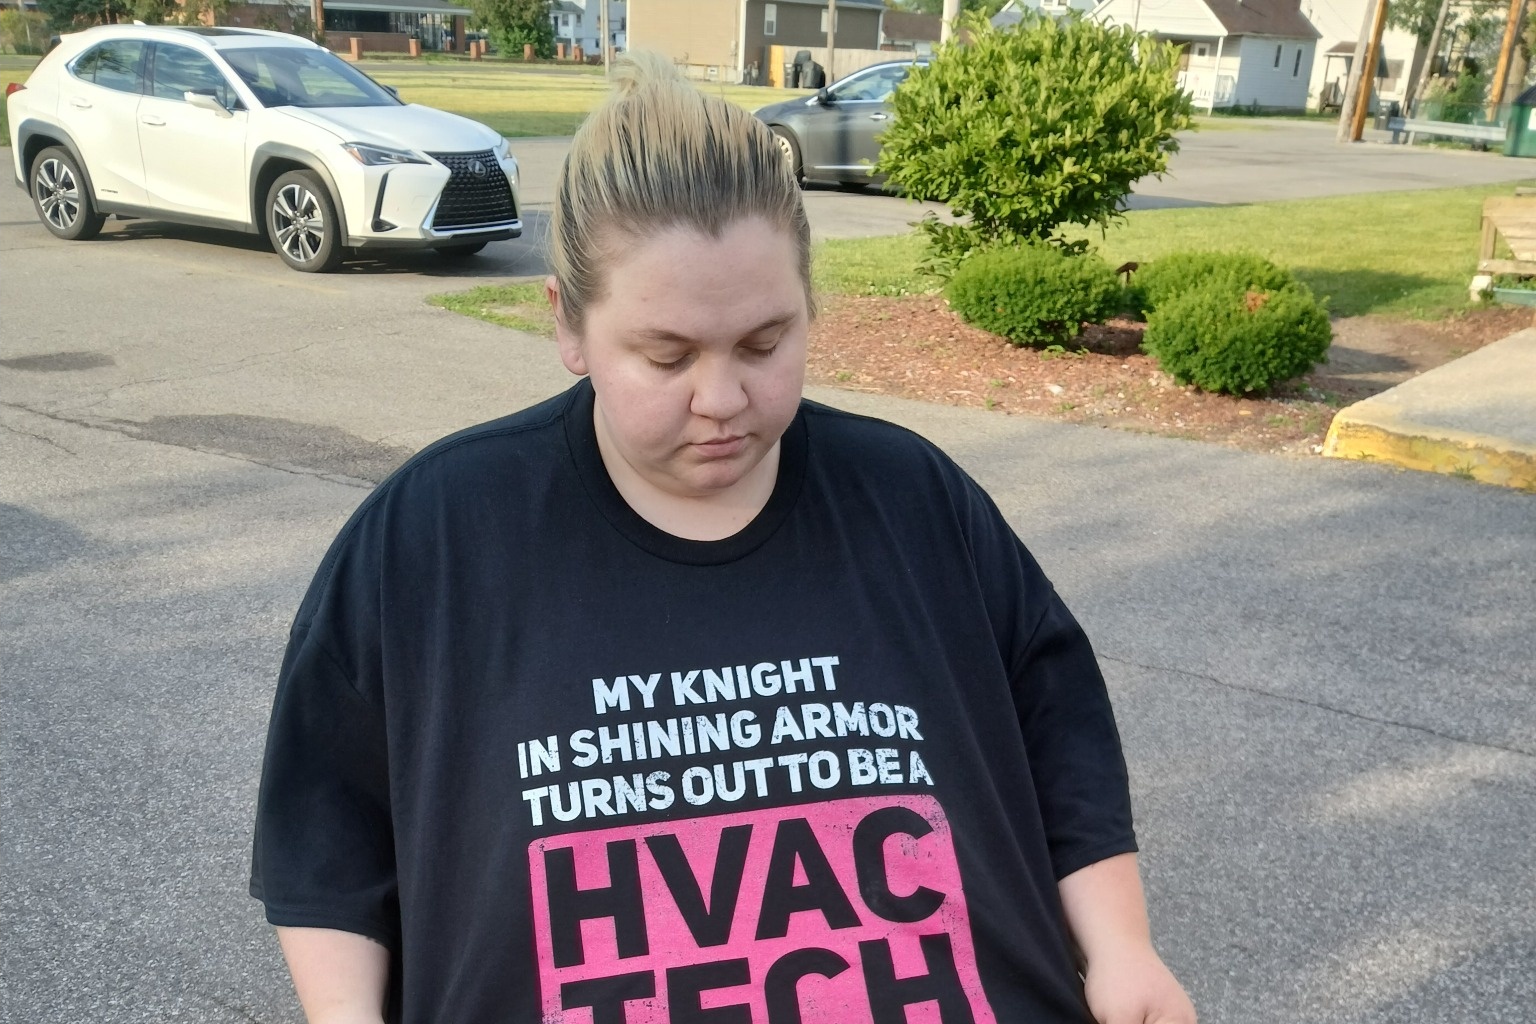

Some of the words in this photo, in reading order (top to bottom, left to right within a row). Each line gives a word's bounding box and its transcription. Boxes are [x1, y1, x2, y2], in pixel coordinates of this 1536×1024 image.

[592, 673, 662, 715] MY
[671, 656, 840, 706] KNIGHT
[517, 735, 561, 779] IN
[570, 710, 762, 768] SHINING
[771, 702, 925, 745] ARMOR
[522, 771, 675, 827] TURNS
[682, 757, 775, 806] OUT
[777, 749, 841, 793] TO
[847, 748, 904, 788] BE
[907, 749, 935, 787] A
[544, 806, 946, 968] HVAC
